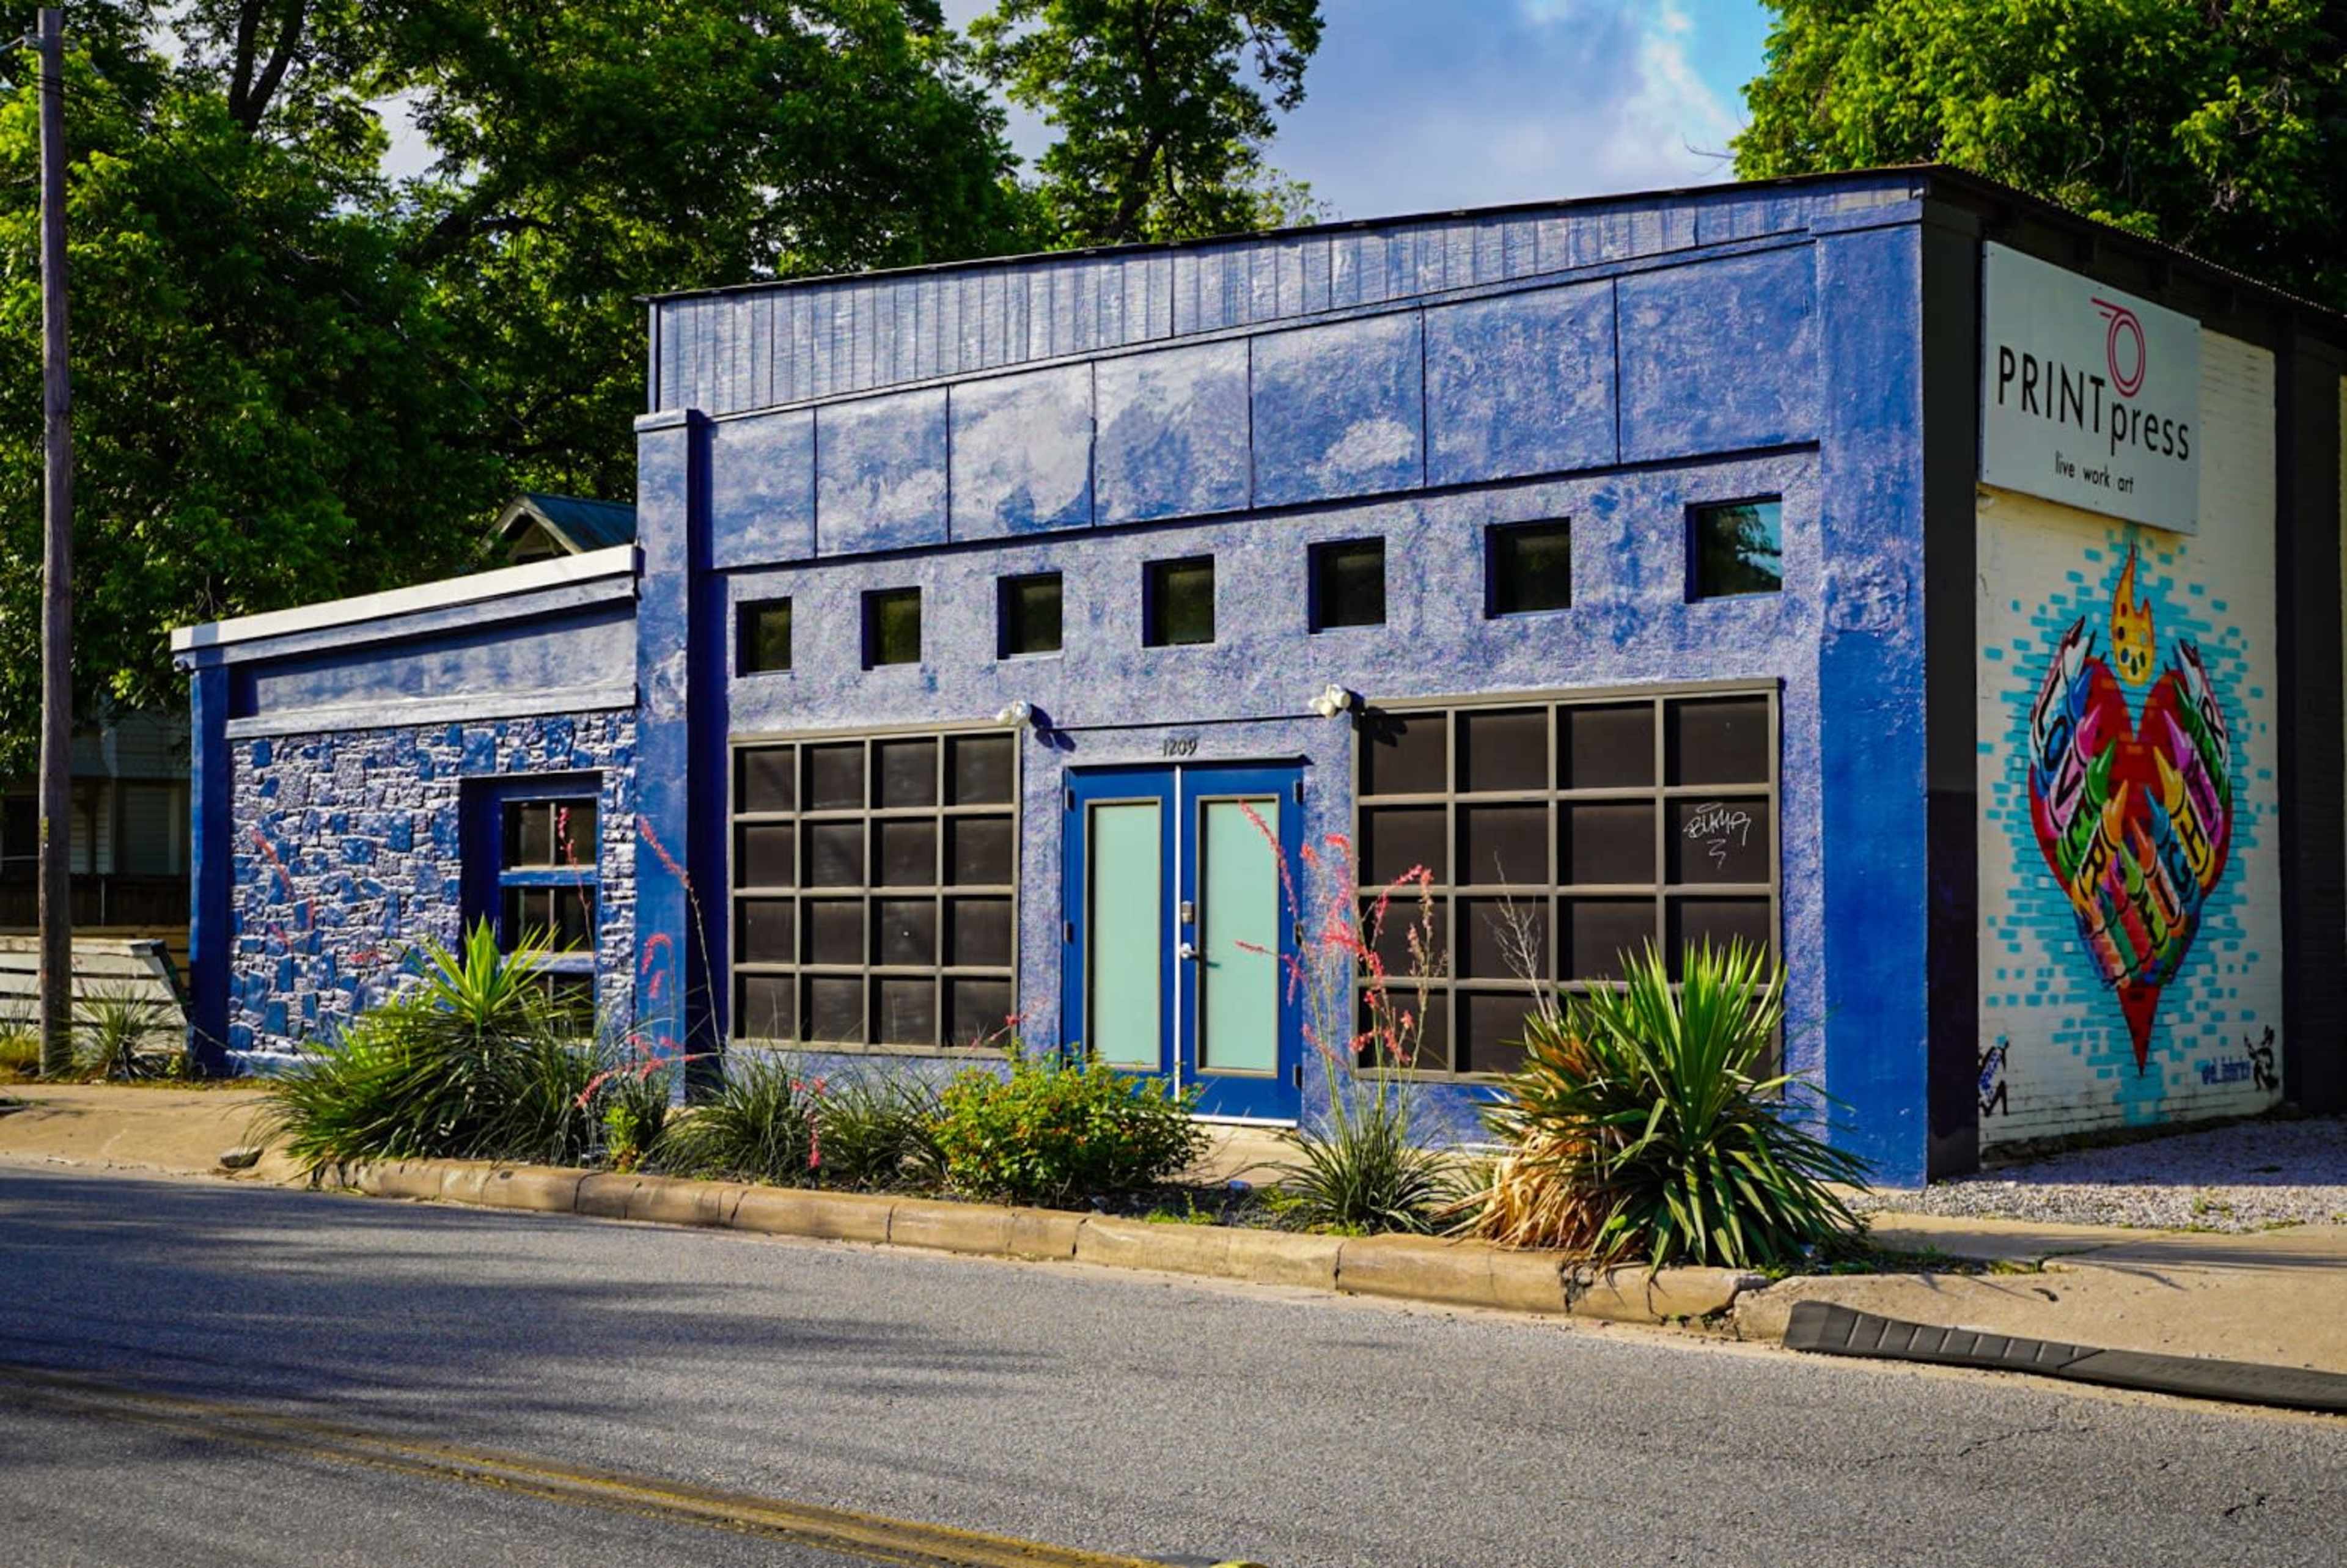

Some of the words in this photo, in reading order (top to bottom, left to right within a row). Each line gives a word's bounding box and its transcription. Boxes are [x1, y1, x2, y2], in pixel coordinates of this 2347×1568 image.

[1997, 345, 2190, 461] PRINTpress
[2055, 450, 2076, 478] live
[2083, 465, 2110, 488] work
[2117, 477, 2134, 494] art
[1162, 737, 1198, 757] 1209
